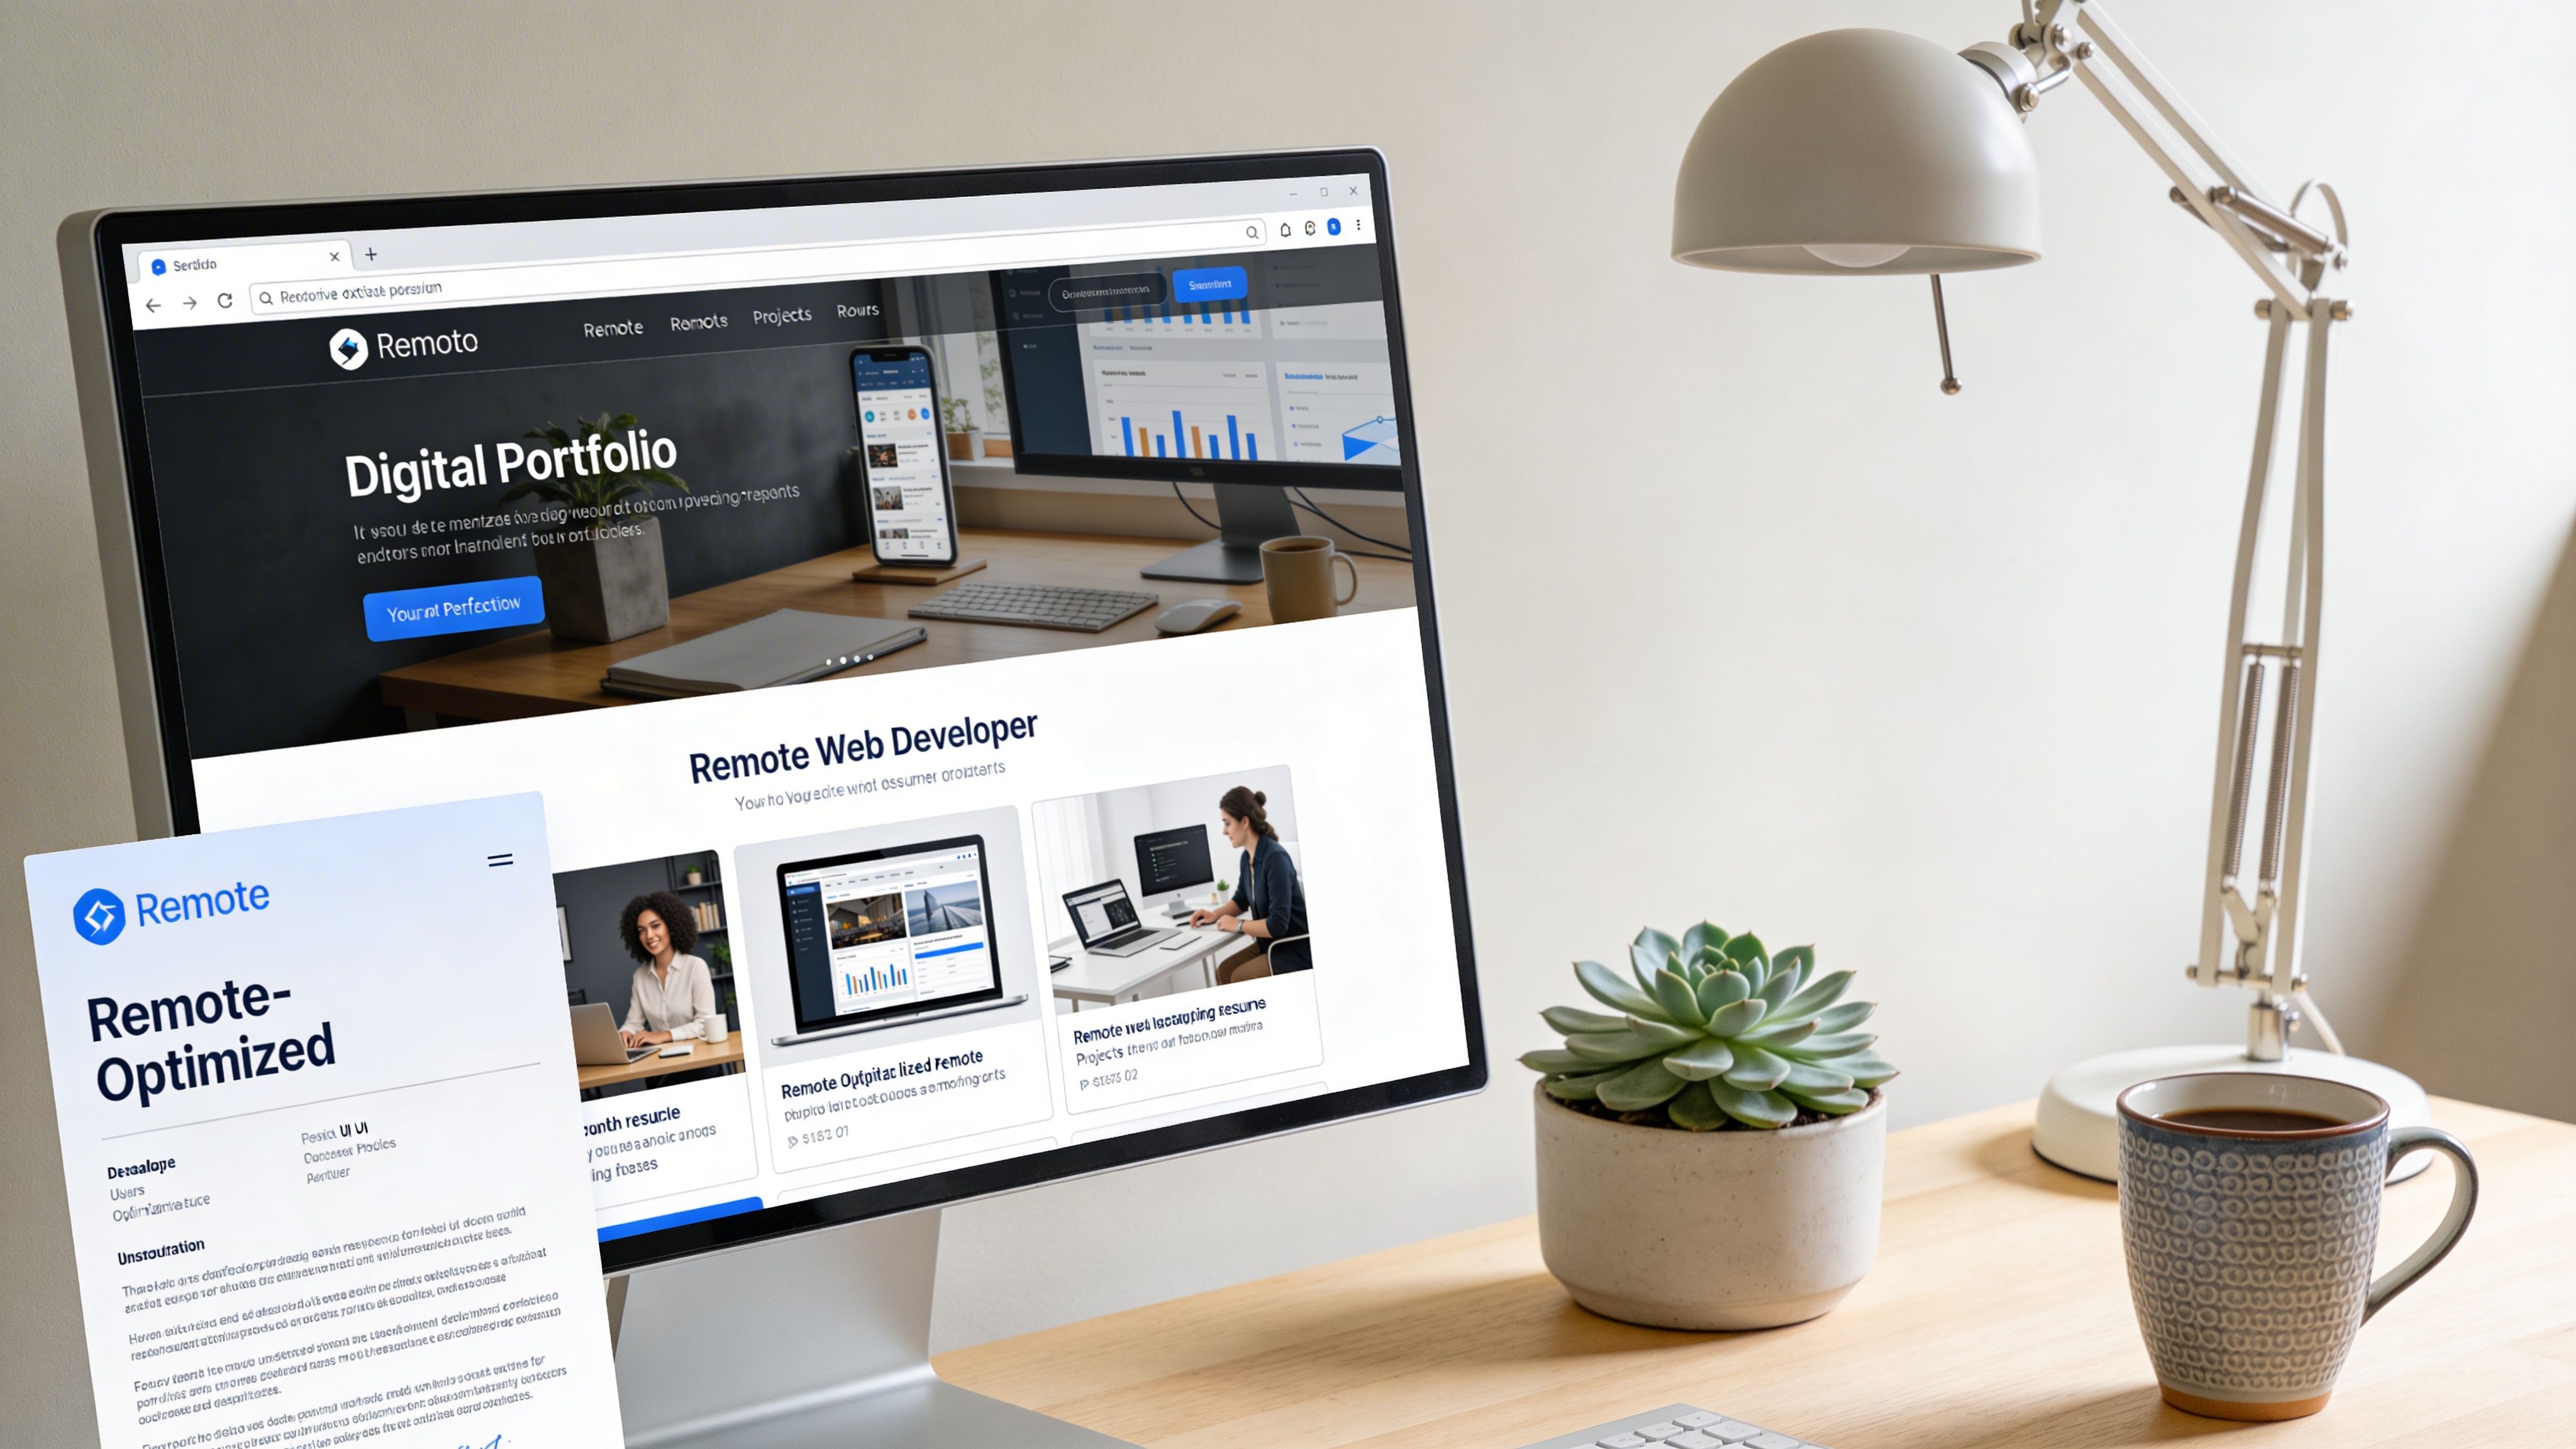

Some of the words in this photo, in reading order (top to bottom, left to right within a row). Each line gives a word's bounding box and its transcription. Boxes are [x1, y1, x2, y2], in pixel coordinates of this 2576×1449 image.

[753, 308, 813, 327] Projects
[377, 329, 479, 358] Remoto
[346, 442, 488, 504] Digital
[497, 428, 678, 484] Portfolio
[689, 743, 810, 784] Remote
[815, 730, 884, 766] Web
[891, 714, 1038, 757] Developer
[135, 880, 270, 927] Remote
[87, 979, 292, 1042] Remote-
[1073, 1024, 1123, 1045] Remote
[96, 1021, 336, 1109] Optimized
[1076, 1046, 1124, 1066] Projects
[781, 1077, 838, 1099] Remote
